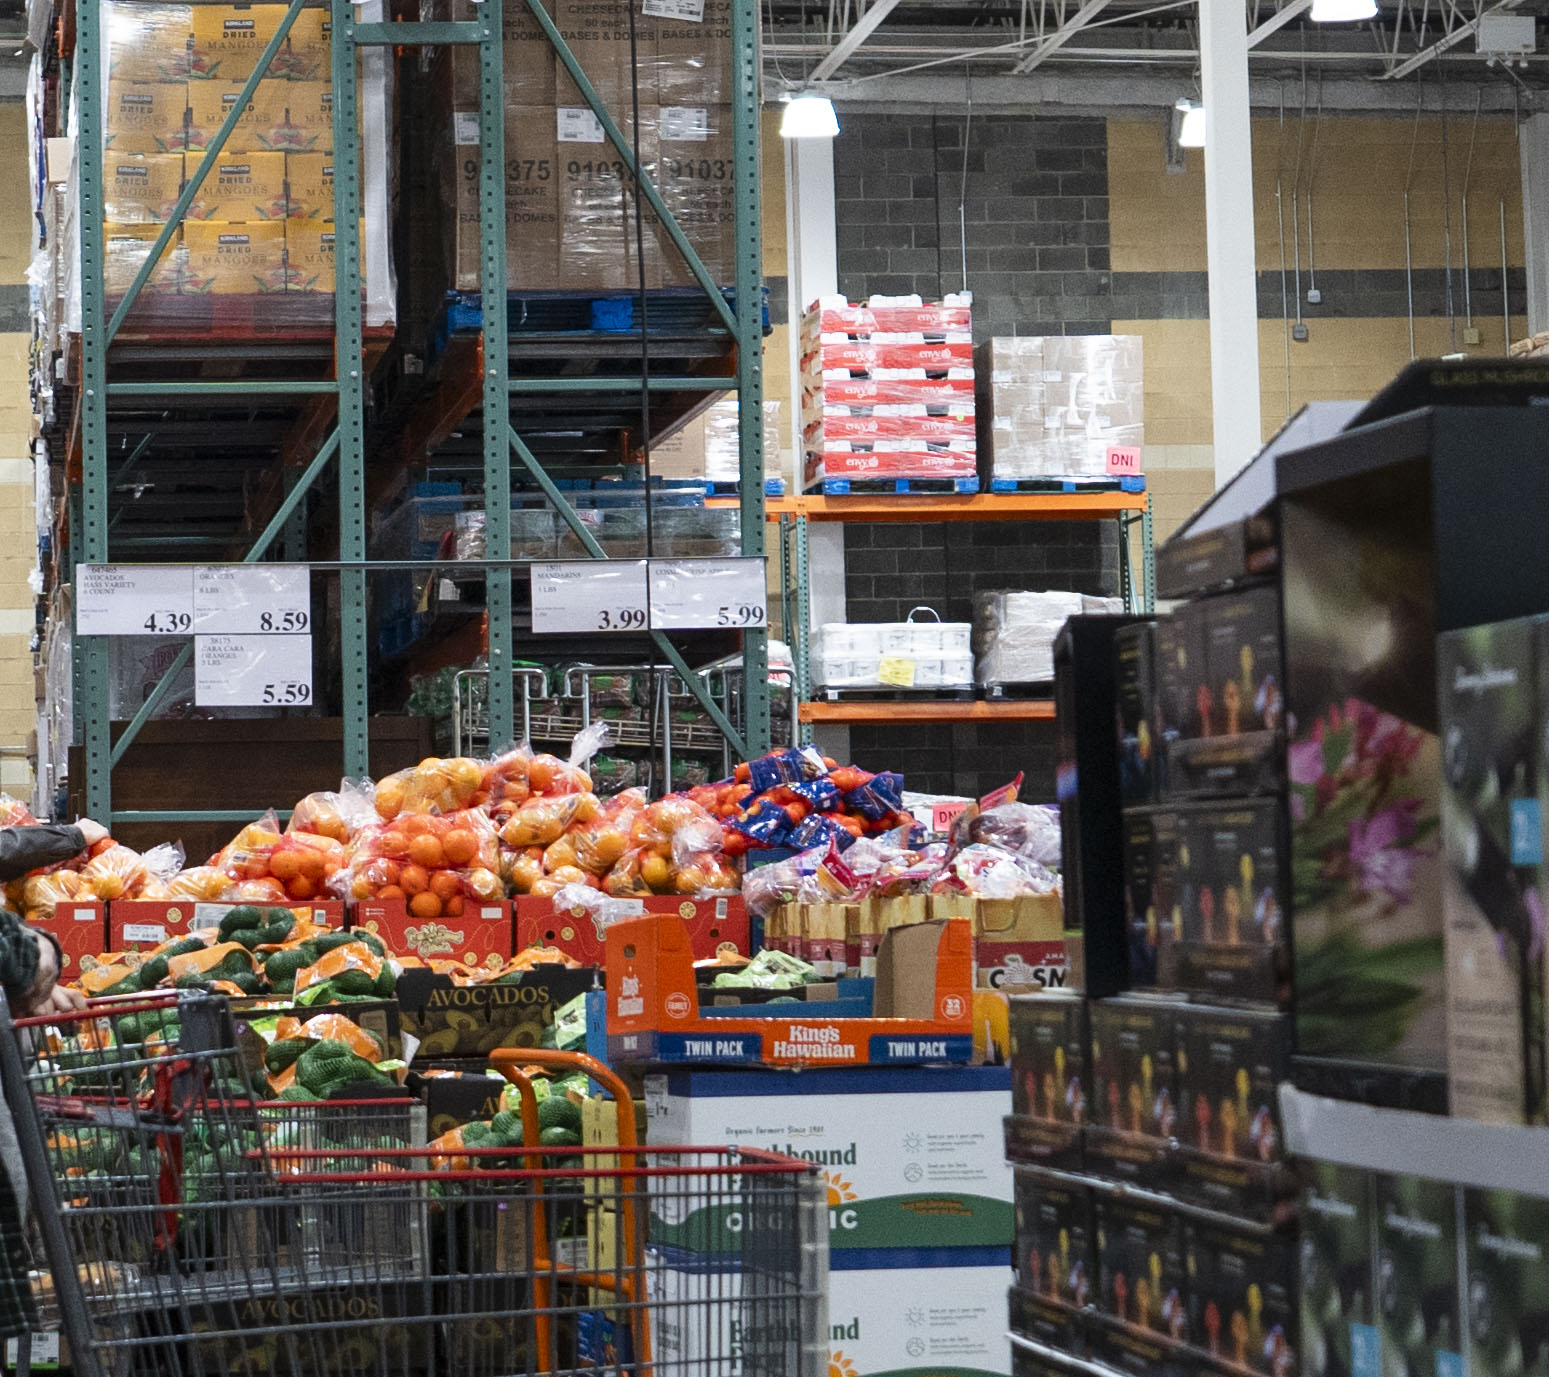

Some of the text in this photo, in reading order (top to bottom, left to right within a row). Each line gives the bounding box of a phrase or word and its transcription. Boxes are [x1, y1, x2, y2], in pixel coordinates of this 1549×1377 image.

[464, 160, 550, 180] 9375
[115, 177, 149, 185] DRIED
[218, 246, 251, 254] DRIED
[1111, 453, 1134, 468] DNI
[144, 613, 192, 632] 4.39
[260, 611, 308, 632] 8.59
[598, 609, 646, 630] 3.99
[717, 605, 764, 626] 5.99
[262, 684, 310, 704] 5.59
[427, 986, 550, 1008] AVOCADOS
[789, 1025, 840, 1045] King's
[685, 1039, 744, 1057] TWIN PACK
[773, 1039, 856, 1060] Hawaiian
[888, 1040, 947, 1057] TWIN PACK
